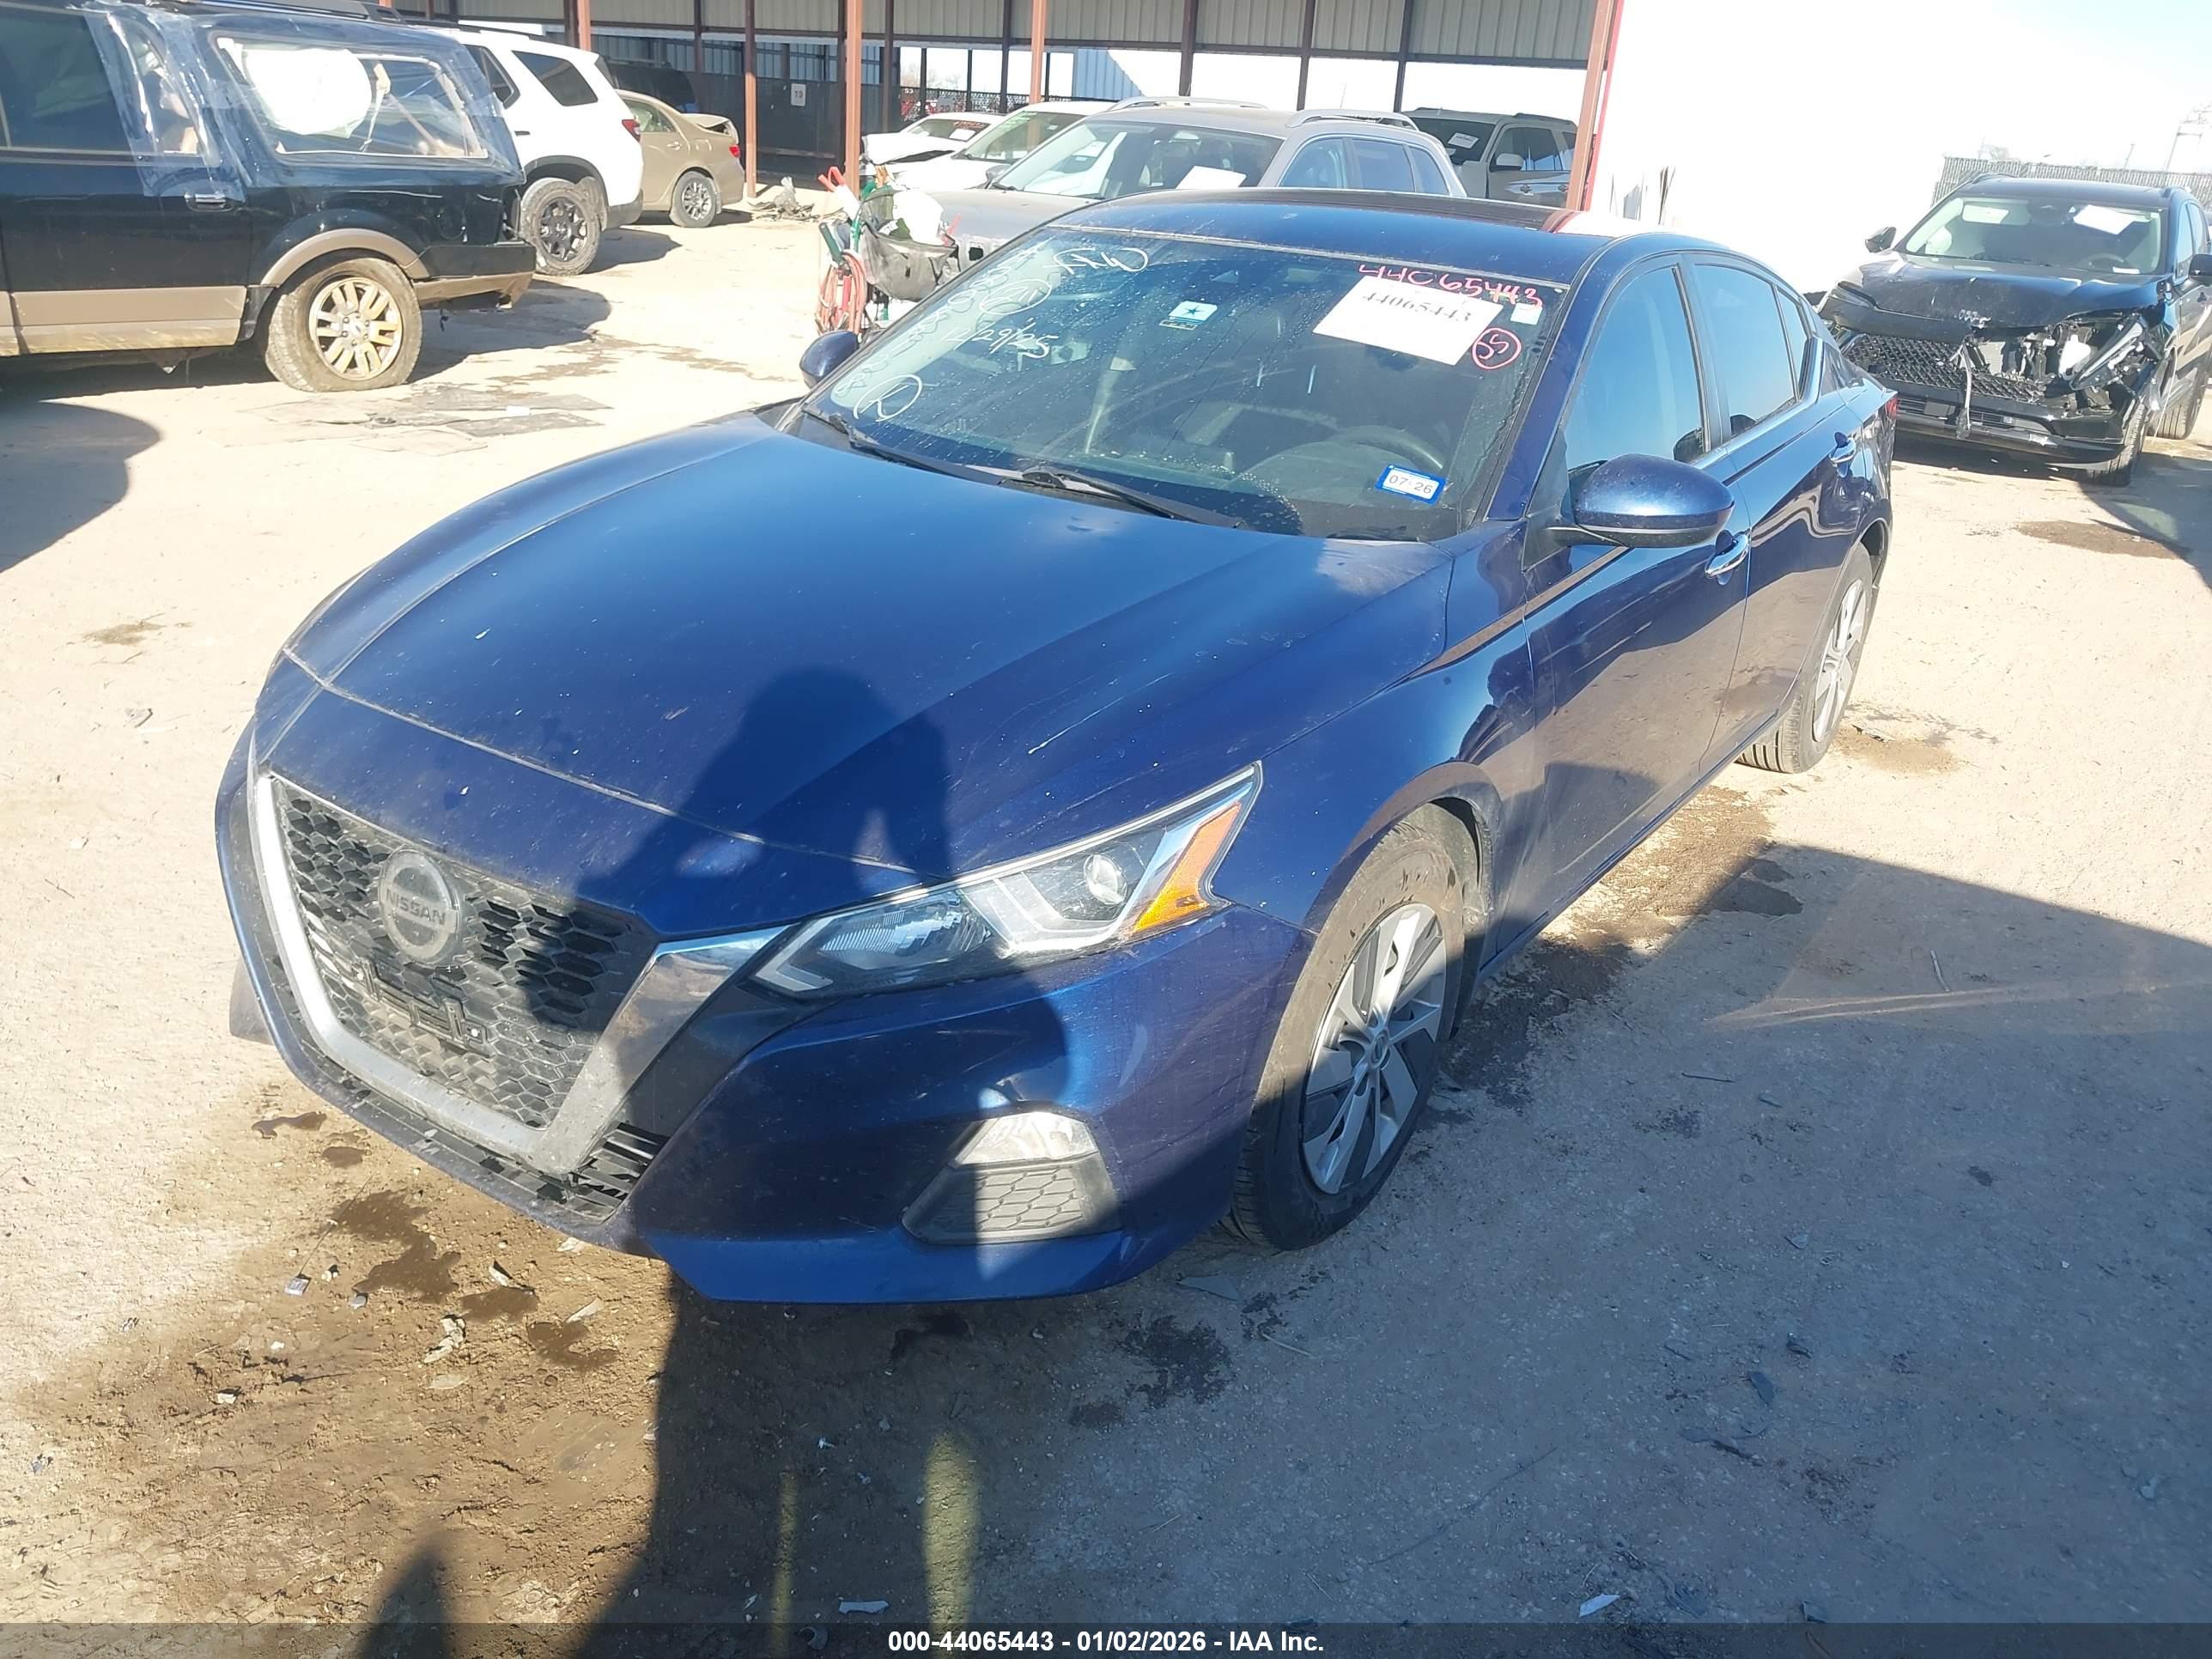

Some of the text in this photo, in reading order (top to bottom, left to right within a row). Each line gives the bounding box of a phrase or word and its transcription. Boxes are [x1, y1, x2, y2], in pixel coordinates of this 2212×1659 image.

[1362, 291, 1472, 322] 44065443
[941, 319, 1060, 359] 12/29/25
[1389, 475, 1434, 495] 07 26
[386, 888, 446, 926] NISSAN
